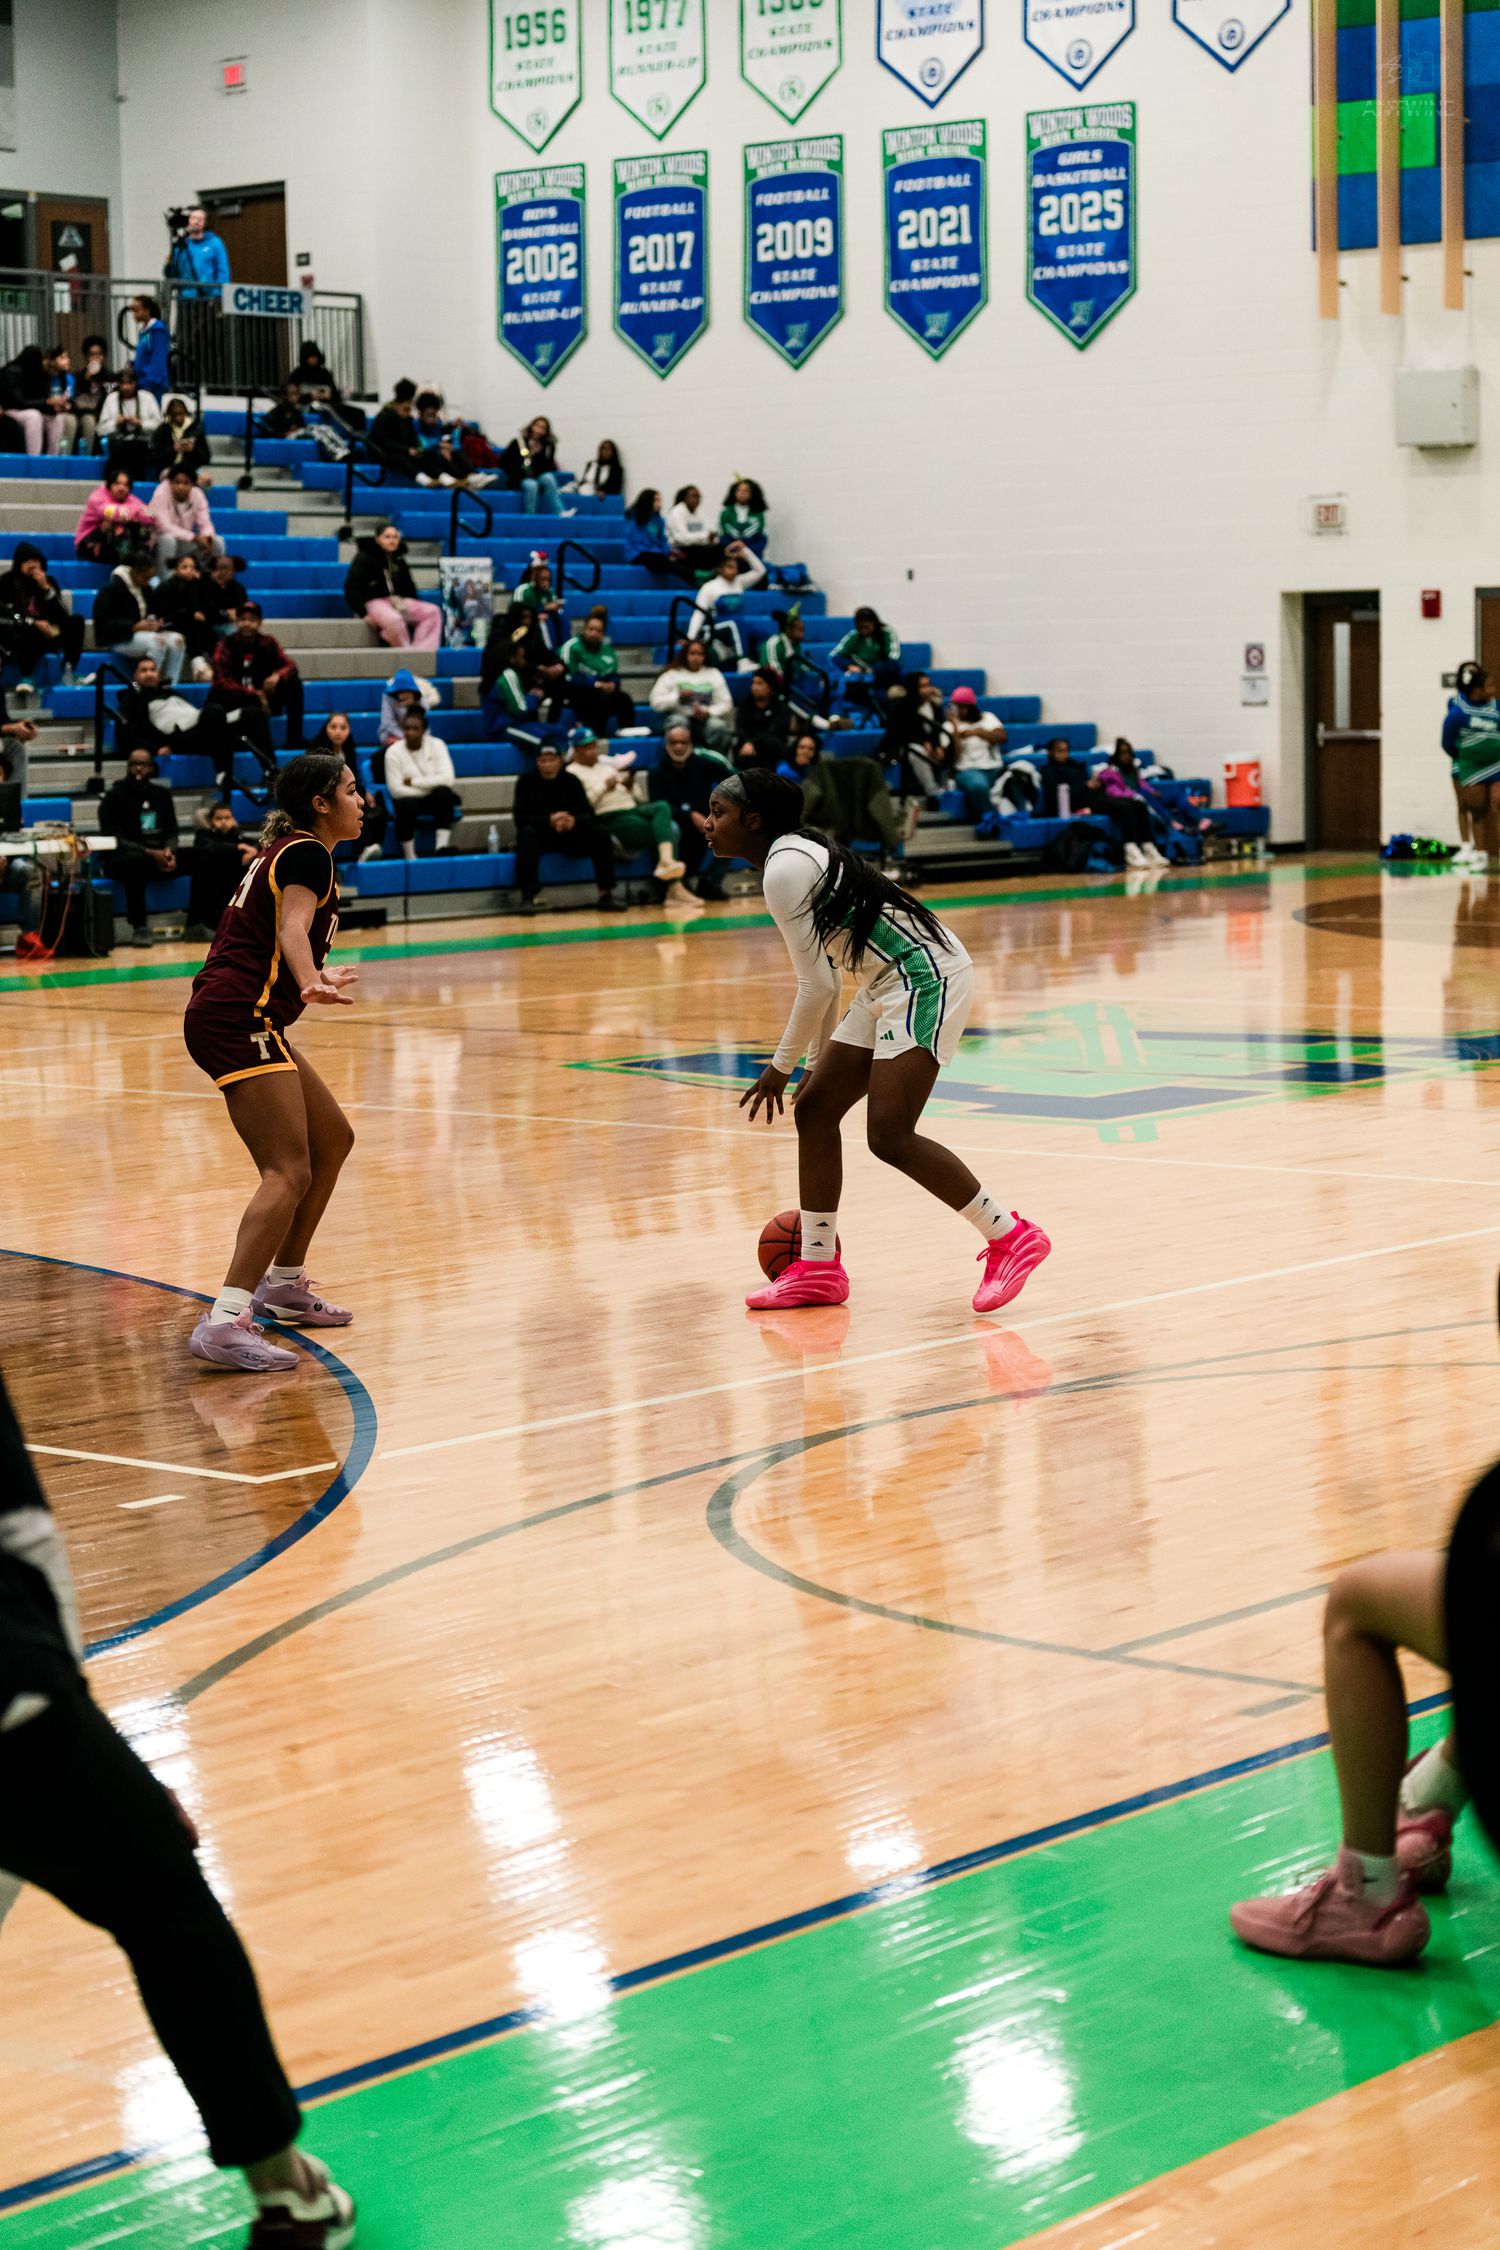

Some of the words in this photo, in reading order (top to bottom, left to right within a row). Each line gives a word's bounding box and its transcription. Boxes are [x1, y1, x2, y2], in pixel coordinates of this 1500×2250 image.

[626, 0, 688, 34] 1977
[504, 8, 567, 51] 1956
[893, 173, 972, 194] FOOTBALL
[755, 187, 830, 207] FOOTBALL
[624, 201, 697, 221] FOOTBALL
[1039, 188, 1124, 236] 2025
[898, 203, 972, 250] 2021
[756, 217, 833, 263] 2009
[1055, 241, 1106, 260] STATE
[506, 241, 578, 285] 2002
[628, 231, 695, 274] 2017
[910, 255, 960, 273] STATE
[1032, 260, 1129, 281] CHAMPIONS
[771, 267, 818, 285] STATE
[889, 273, 980, 293] CHAMPIONS
[639, 279, 683, 296] STATE
[749, 284, 840, 305] CHAMPIONS
[233, 287, 303, 314] CHEER
[250, 1031, 270, 1061] T
